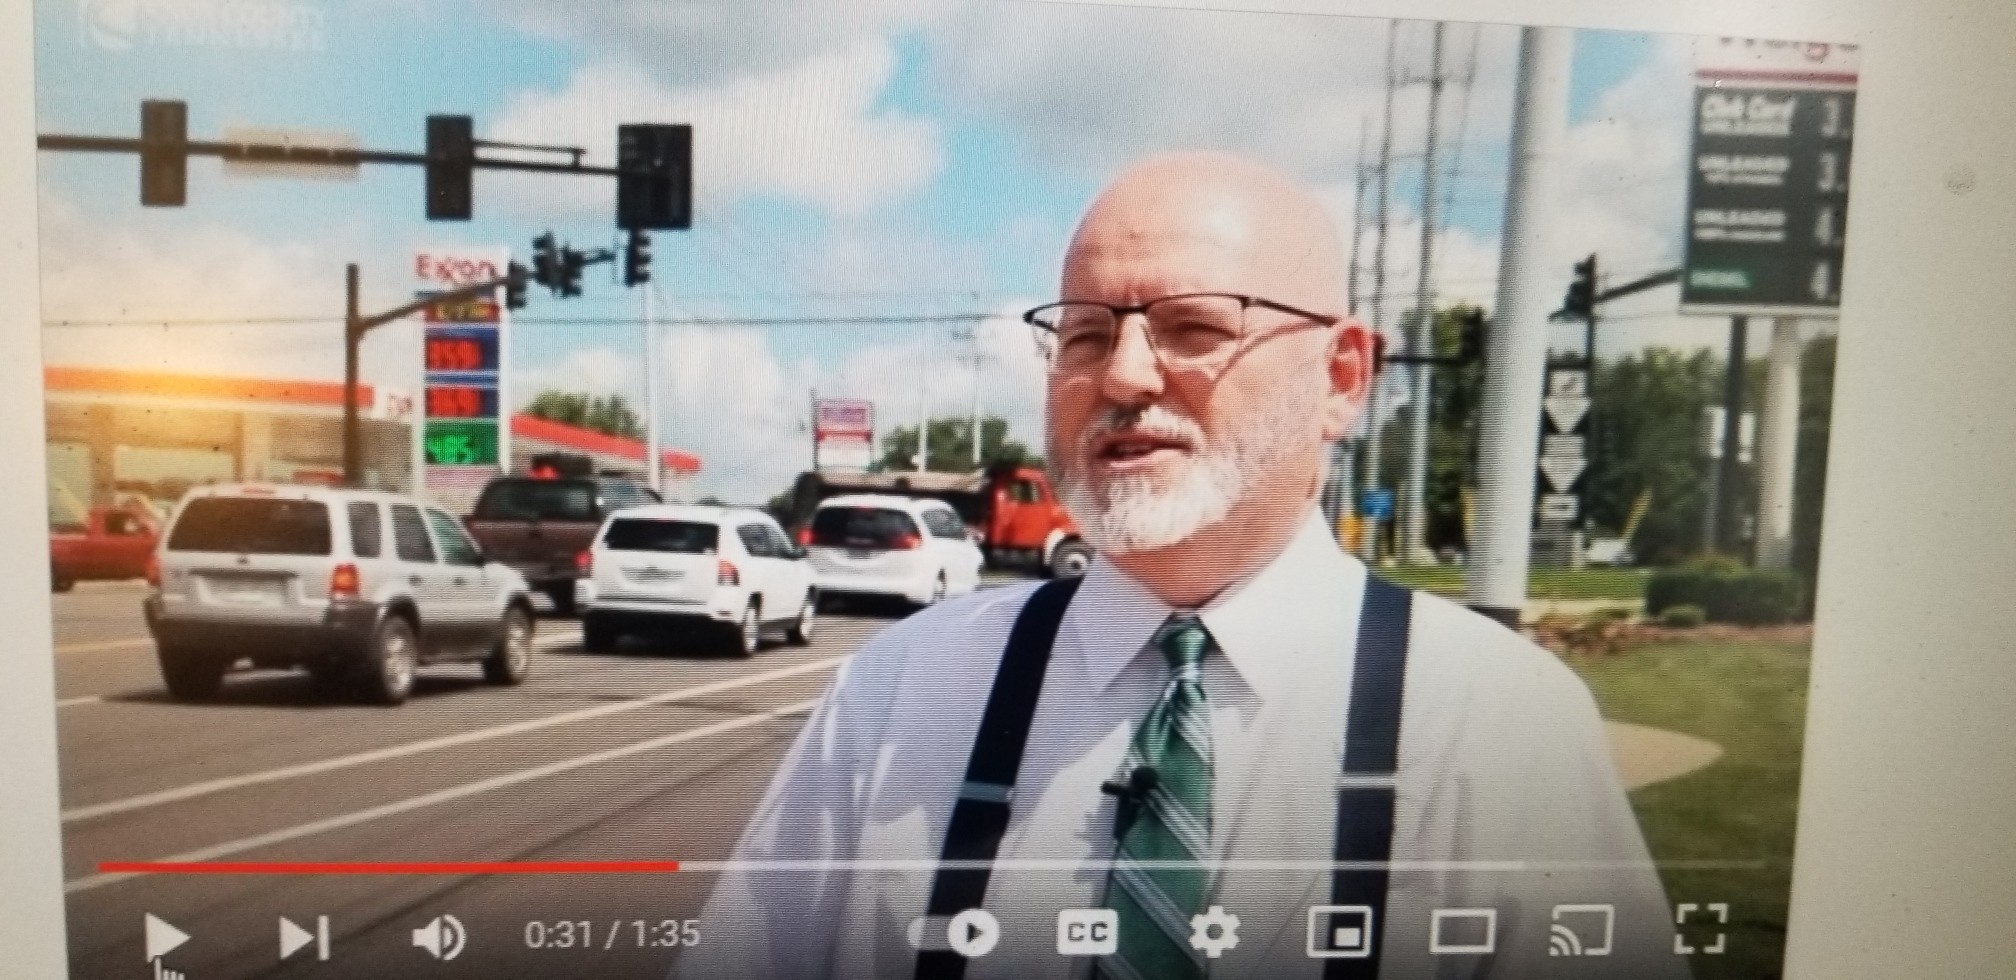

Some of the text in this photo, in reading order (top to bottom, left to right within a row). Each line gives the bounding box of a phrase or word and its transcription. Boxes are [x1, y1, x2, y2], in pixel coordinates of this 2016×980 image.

[416, 253, 496, 283] Exxon
[525, 919, 700, 950] 0:31 / 1:35
[1067, 921, 1108, 942] CC
